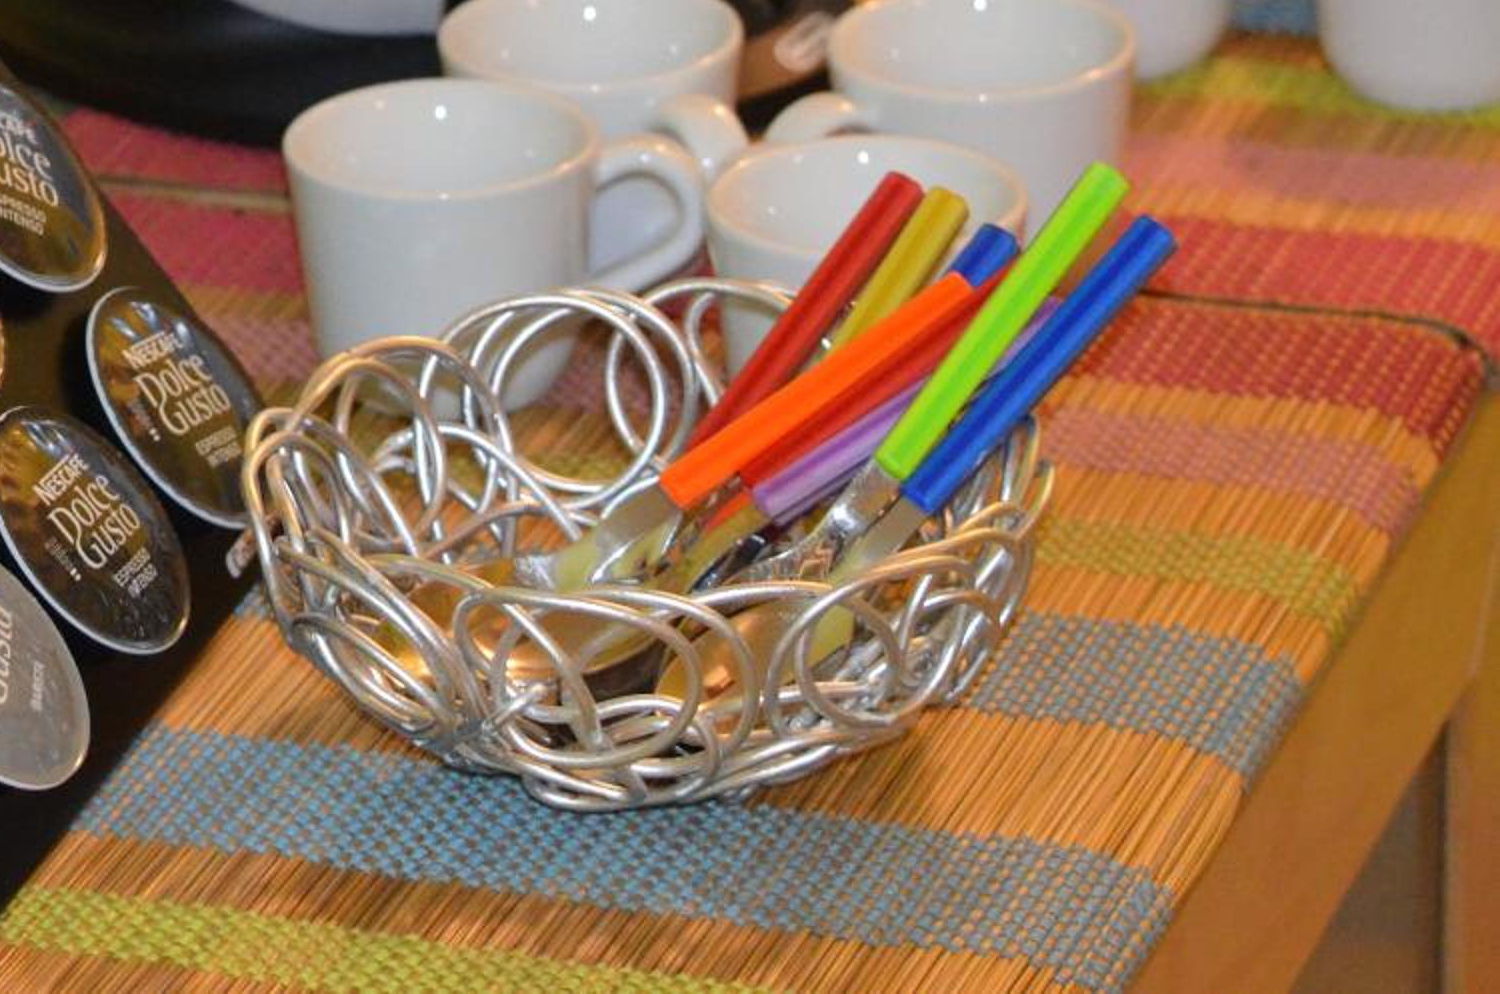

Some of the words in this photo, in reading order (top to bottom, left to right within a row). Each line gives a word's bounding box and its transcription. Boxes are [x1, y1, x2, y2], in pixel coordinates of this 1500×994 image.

[132, 354, 214, 409] Dolce
[157, 382, 233, 437] Gusto
[47, 473, 123, 545] Dolce
[75, 501, 143, 570] Gusto
